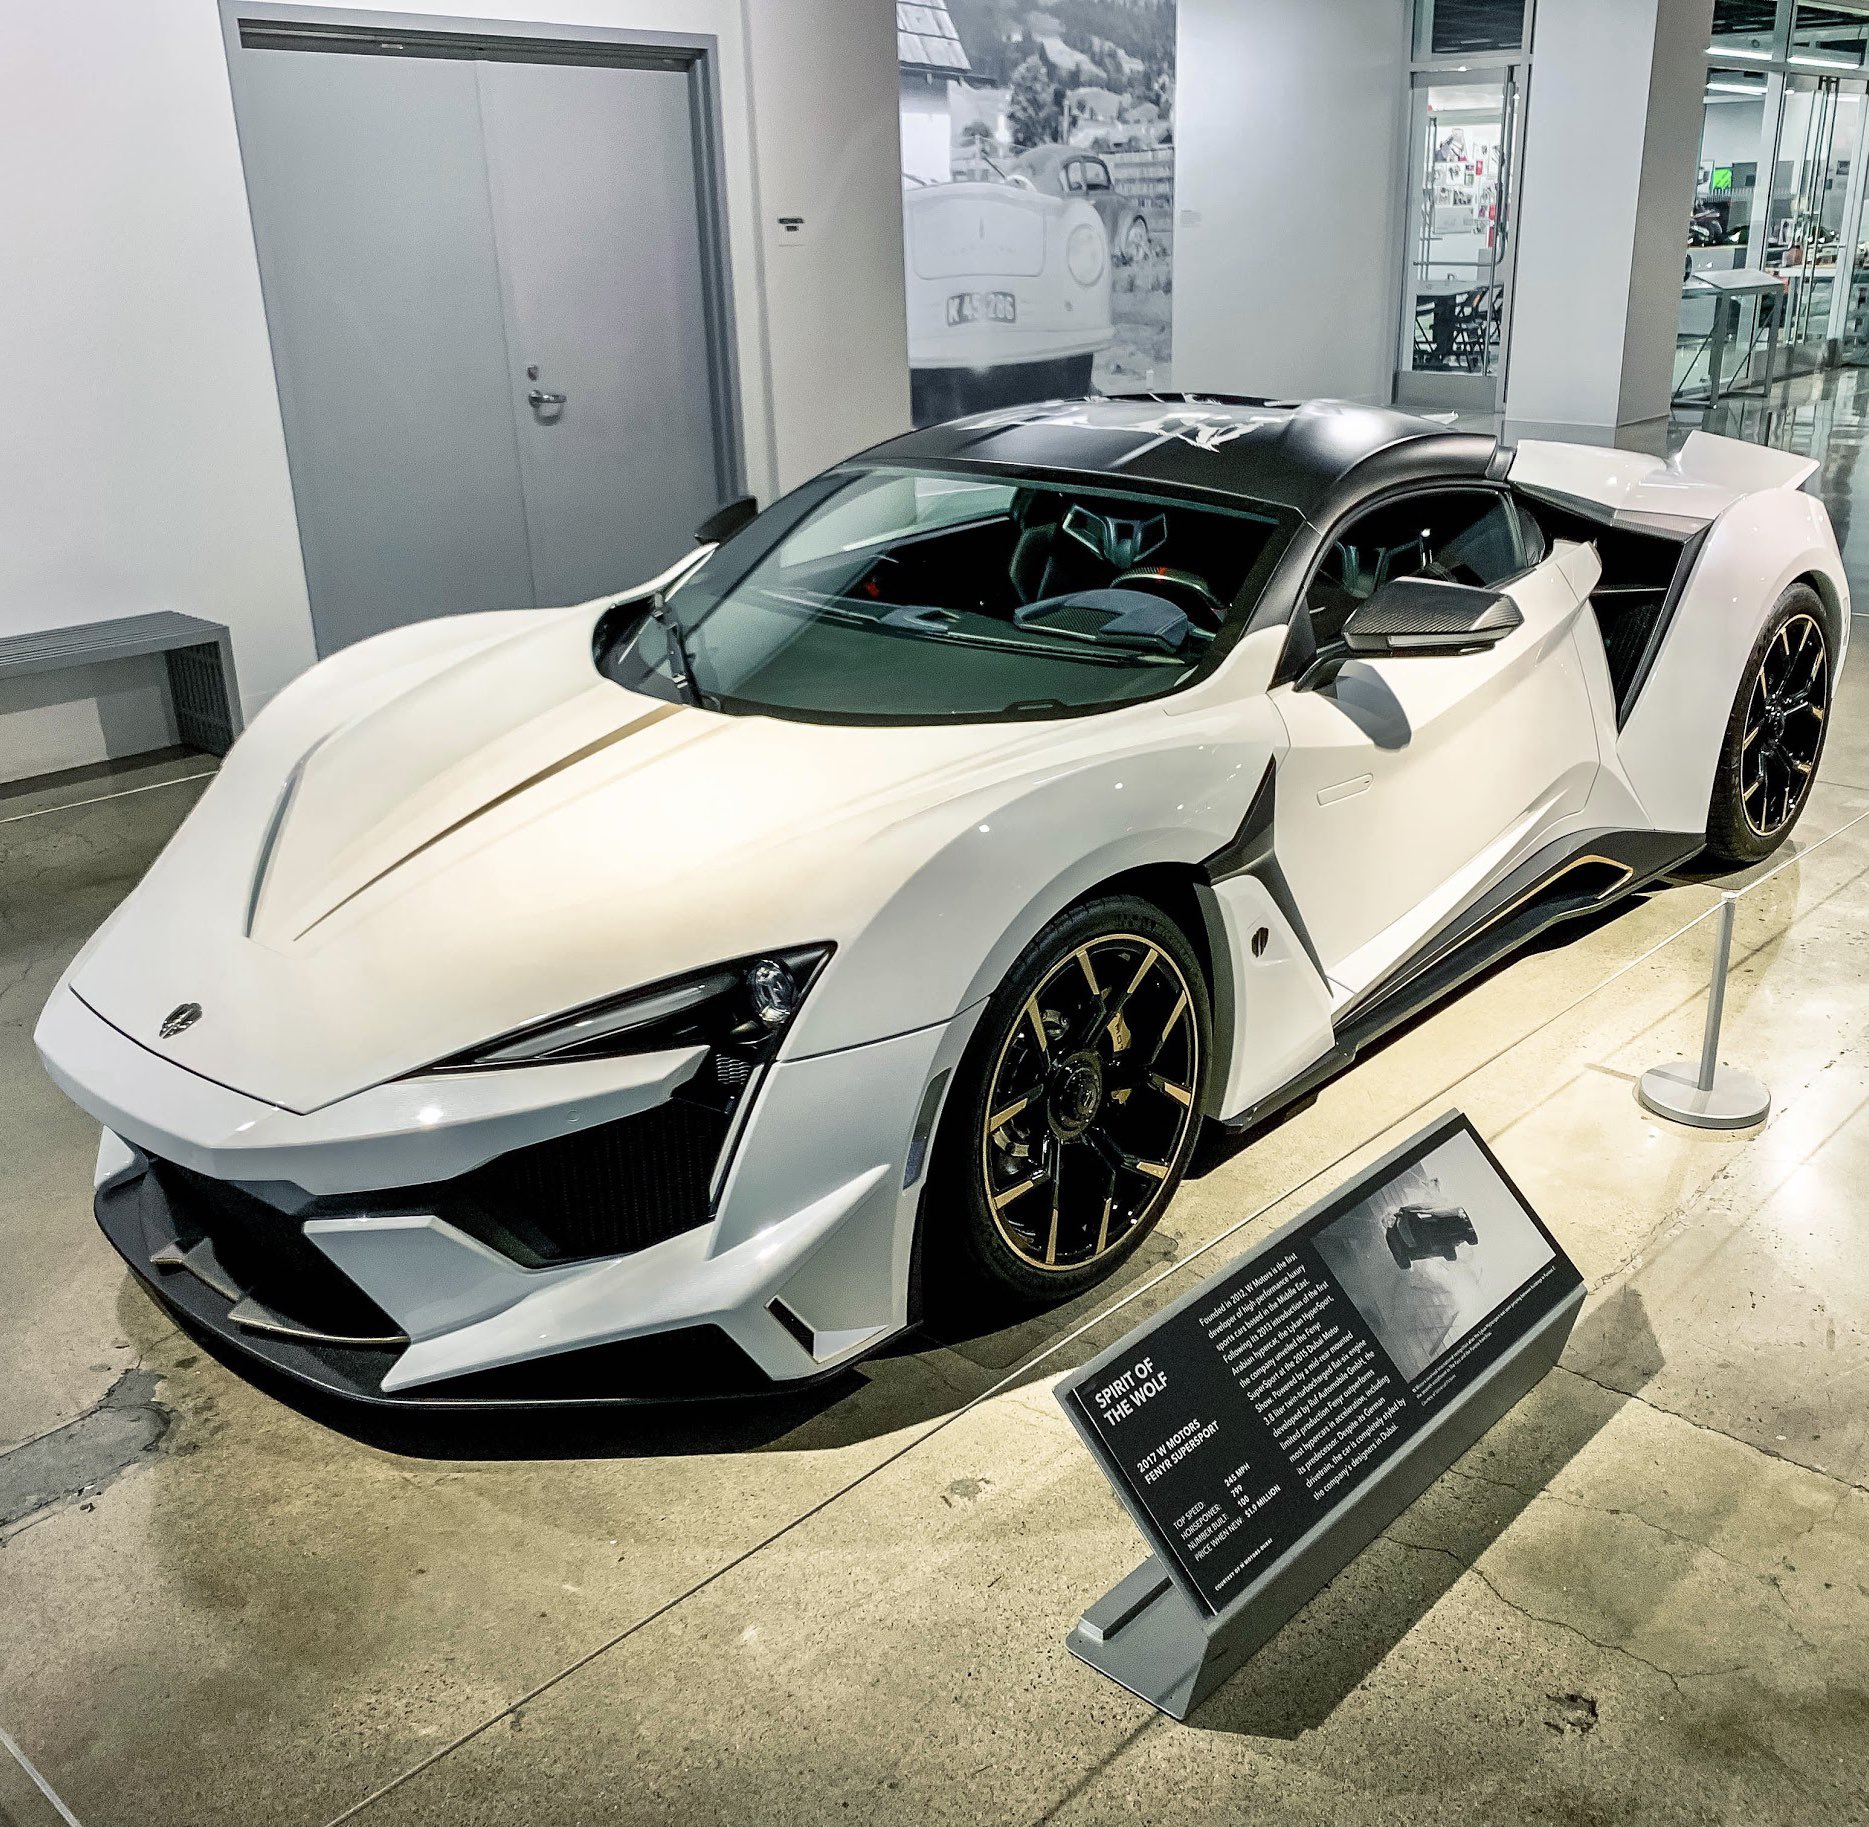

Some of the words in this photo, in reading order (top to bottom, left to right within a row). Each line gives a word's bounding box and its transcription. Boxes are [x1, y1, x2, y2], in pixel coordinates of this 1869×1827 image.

[1199, 1303, 1226, 1327] Founded
[1251, 1270, 1273, 1288] Motors
[1216, 1334, 1236, 1352] sports
[1244, 1310, 1264, 1329] based
[1276, 1287, 1297, 1305] Middle
[1207, 1314, 1237, 1340] developer
[1223, 1339, 1253, 1364] Following
[1270, 1300, 1304, 1327] introduction
[1348, 1339, 1367, 1357] engine
[1094, 1370, 1136, 1409] SPIRIT
[1134, 1356, 1154, 1380] OF
[1231, 1355, 1255, 1376] Arabian
[1247, 1372, 1281, 1401] SuperSport
[1306, 1336, 1324, 1354] Dubai
[1250, 1358, 1277, 1381] company
[1274, 1338, 1298, 1361] unveiled
[1271, 1375, 1298, 1400] Powered
[1329, 1330, 1354, 1354] mounted
[1103, 1398, 1134, 1427] THE
[1129, 1371, 1169, 1407] WOLF
[1272, 1408, 1303, 1438] developed
[1317, 1371, 1349, 1400] Automobile
[1279, 1429, 1301, 1450] limited
[1299, 1406, 1331, 1436] production
[1327, 1393, 1345, 1411] Fenyr
[1342, 1368, 1375, 1398] outperforms
[1301, 1425, 1331, 1452] hypercars
[1364, 1374, 1391, 1398] including
[1336, 1419, 1359, 1441] Despite
[1363, 1396, 1386, 1417] German
[1355, 1416, 1385, 1445] completely
[1382, 1401, 1400, 1421] styled
[1137, 1452, 1158, 1473] 2017
[1165, 1418, 1201, 1450] MOTORS
[1144, 1458, 1173, 1485] FENYR
[1170, 1420, 1220, 1464] SUPERSPORT
[1350, 1442, 1378, 1468] designers
[1187, 1526, 1214, 1551] NUMBER
[1194, 1543, 1213, 1562] PRICE
[1210, 1528, 1230, 1548] WHEN
[1256, 1484, 1281, 1508] MILLION
